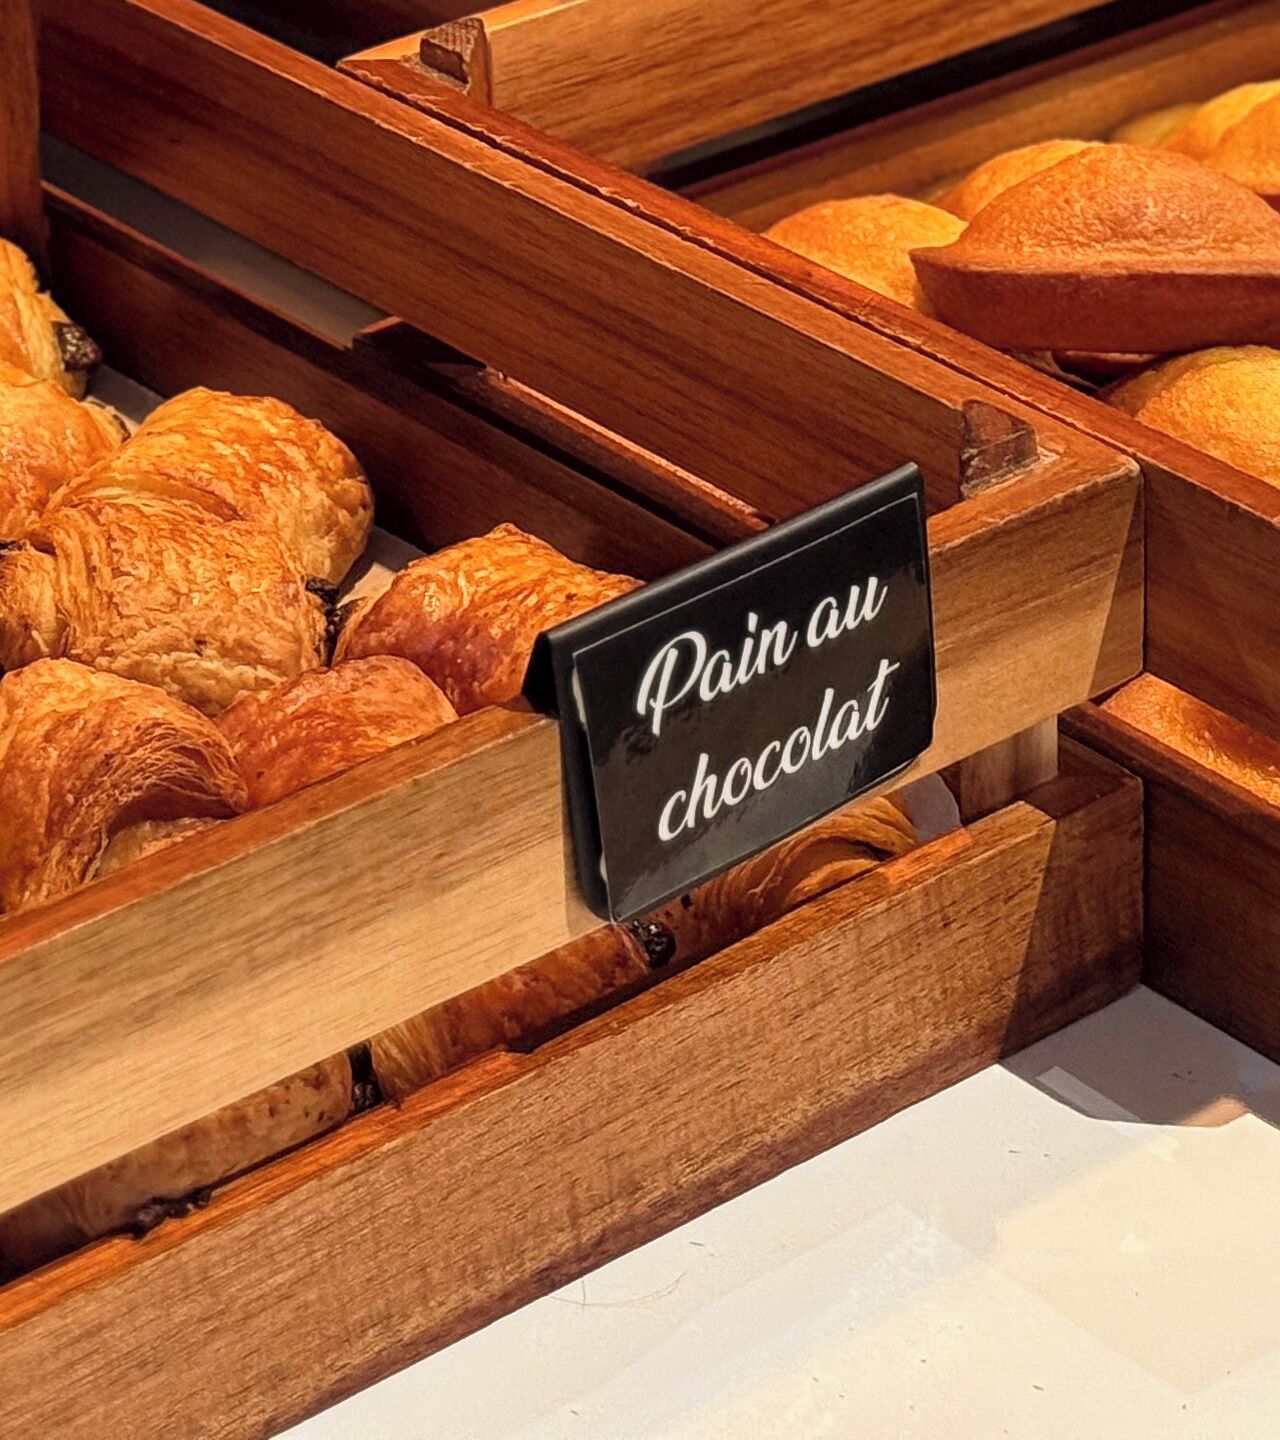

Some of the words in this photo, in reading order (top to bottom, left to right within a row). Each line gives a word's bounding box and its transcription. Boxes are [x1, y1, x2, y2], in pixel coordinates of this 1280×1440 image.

[636, 611, 799, 737] Pain
[805, 576, 888, 649] au
[657, 658, 901, 843] chocolat
